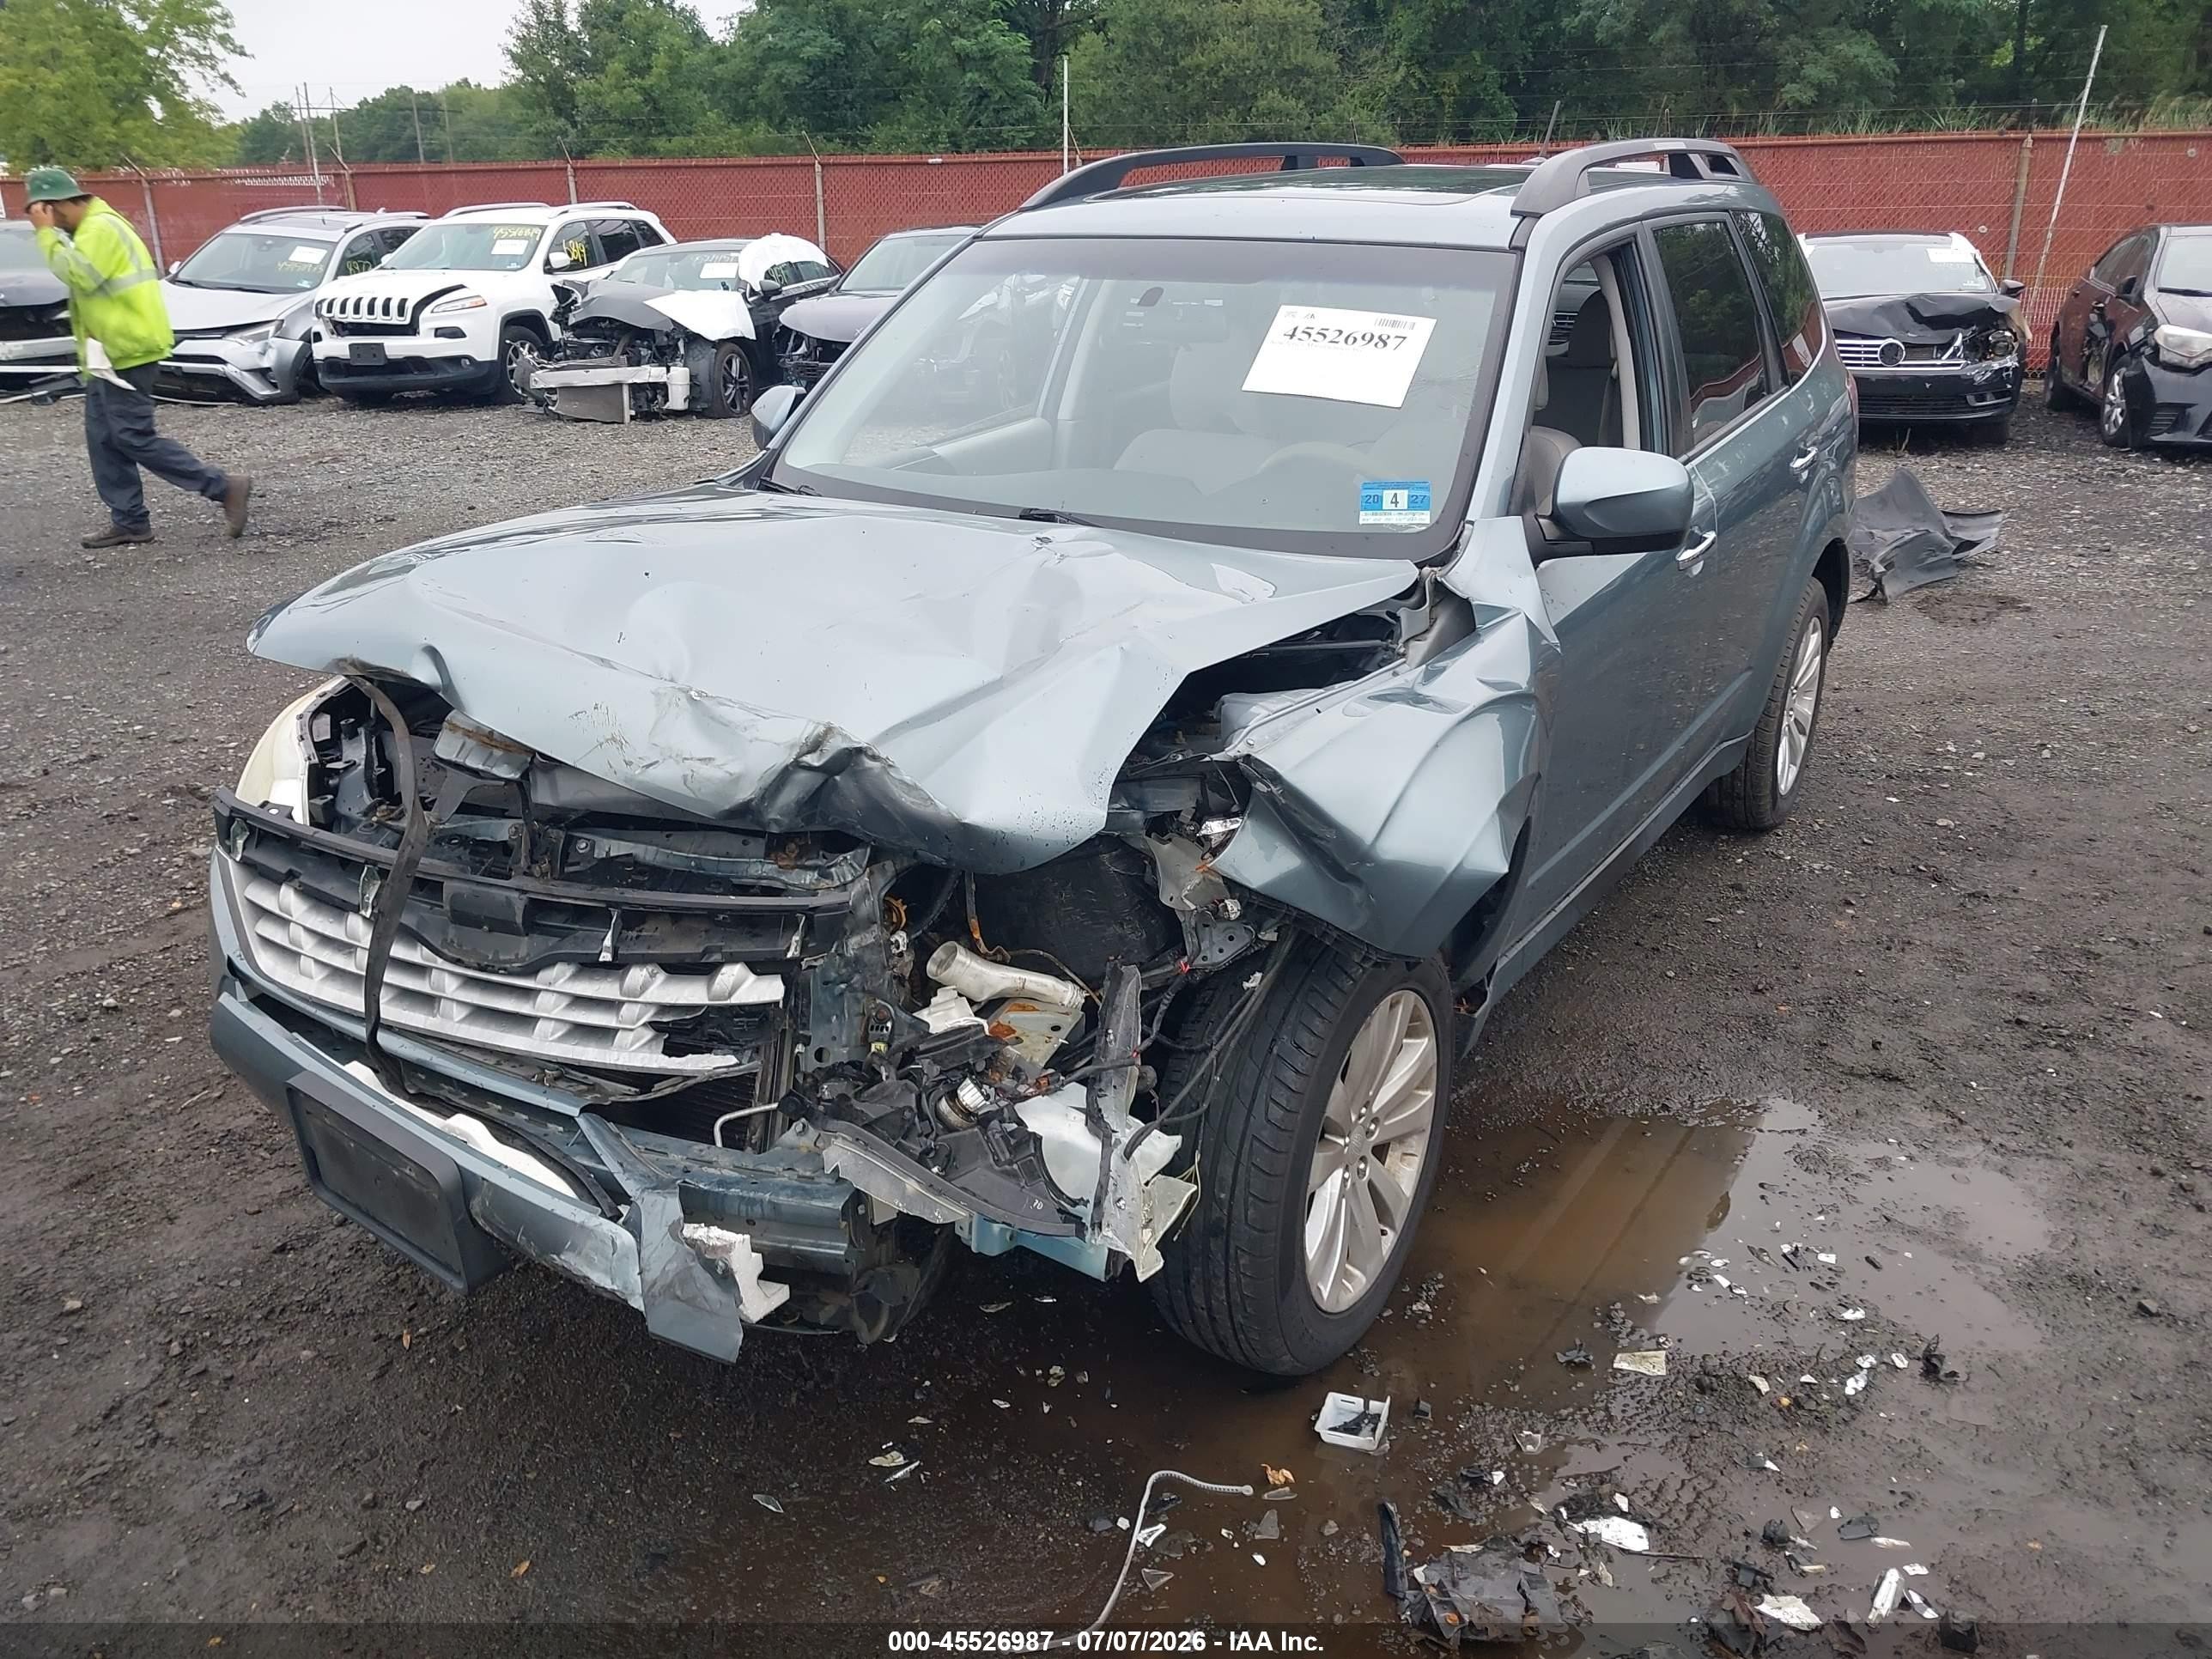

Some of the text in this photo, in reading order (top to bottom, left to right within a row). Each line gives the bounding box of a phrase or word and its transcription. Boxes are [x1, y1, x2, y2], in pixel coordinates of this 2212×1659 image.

[562, 240, 587, 267] 6819
[1283, 325, 1408, 351] 45526987
[1364, 492, 1427, 508] 20 4 27
